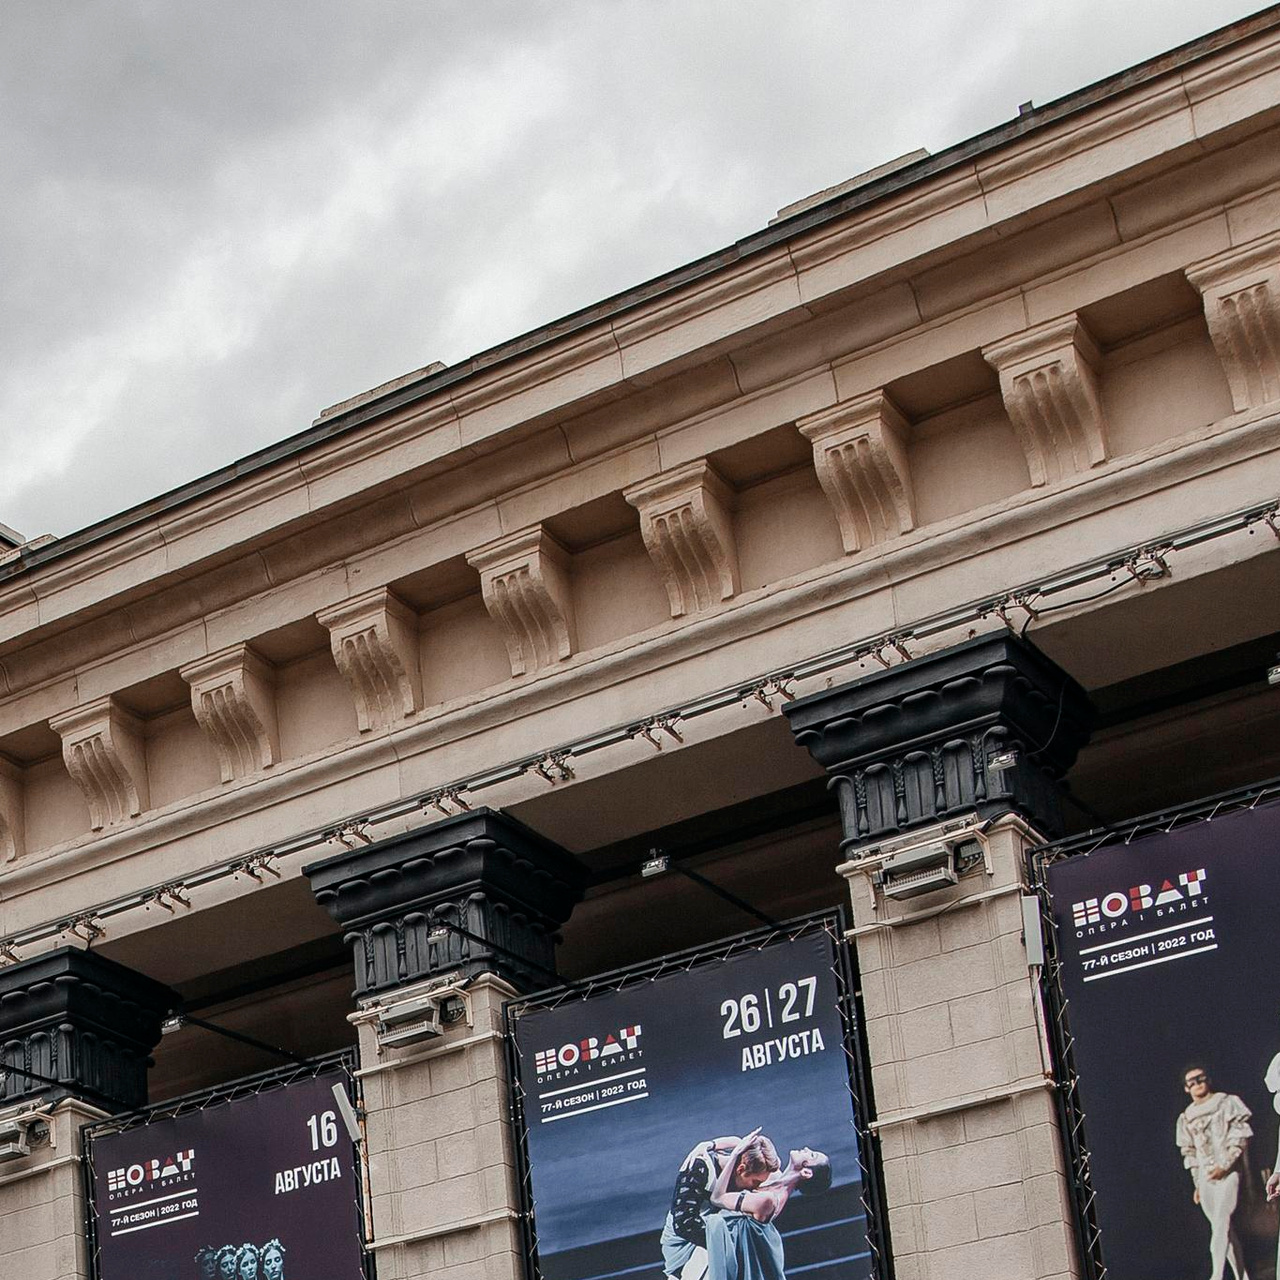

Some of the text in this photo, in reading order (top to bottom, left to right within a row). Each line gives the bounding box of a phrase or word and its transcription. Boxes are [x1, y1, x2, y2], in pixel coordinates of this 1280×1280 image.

[1072, 868, 1206, 927] НОВАТ
[1076, 896, 1208, 938] ОПЕРА БАЛЕТ
[1082, 928, 1215, 970] 77-Й СЕЗОН 2022 ГОД
[720, 976, 816, 1039] 26 27
[535, 1025, 641, 1074] НОВАТ
[537, 1050, 642, 1083] ОПЕРА БАЛЕТ
[742, 1028, 825, 1071] АВГУСТА
[541, 1079, 646, 1112] 77-Й СЕЗОН 2022 ГОД
[307, 1110, 337, 1150] 16
[107, 1149, 194, 1191] НОВАТ
[109, 1172, 195, 1200] ОПЕРА БАЛЕТ
[275, 1157, 341, 1194] АВГУСТА
[111, 1198, 198, 1226] 77-Й СЕЗОН 2022 ГОД
